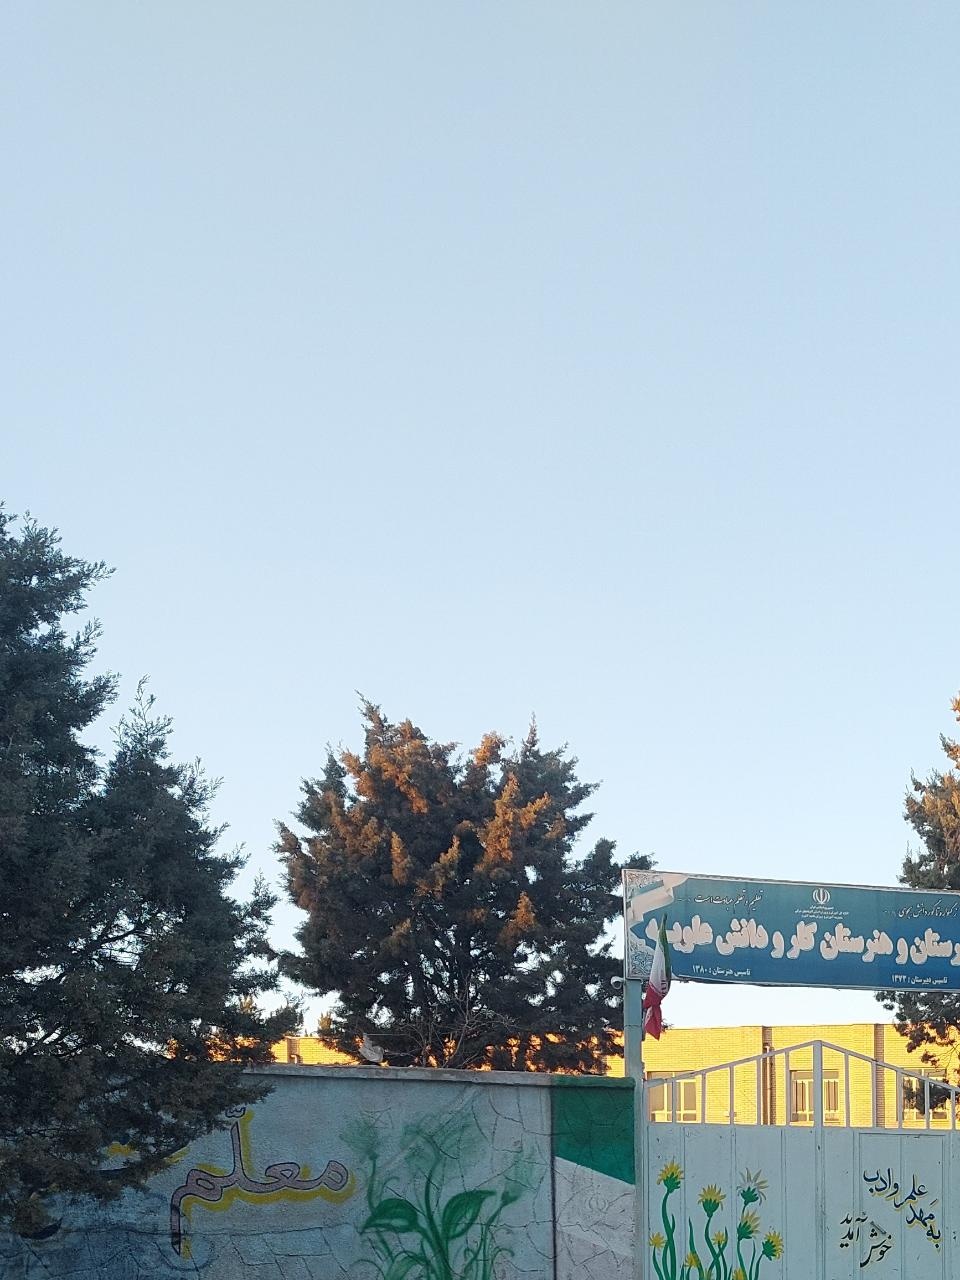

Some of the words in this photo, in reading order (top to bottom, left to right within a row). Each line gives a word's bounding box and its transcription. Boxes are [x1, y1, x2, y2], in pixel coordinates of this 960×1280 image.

[715, 917, 769, 956] دانش
[770, 930, 785, 959] و
[786, 920, 818, 959] کار
[819, 922, 894, 963] هنرستان
[895, 937, 909, 965] و
[863, 1168, 892, 1193] ادب
[893, 1174, 928, 1208] علم
[860, 1228, 892, 1268] خوش
[926, 1224, 941, 1249] به
